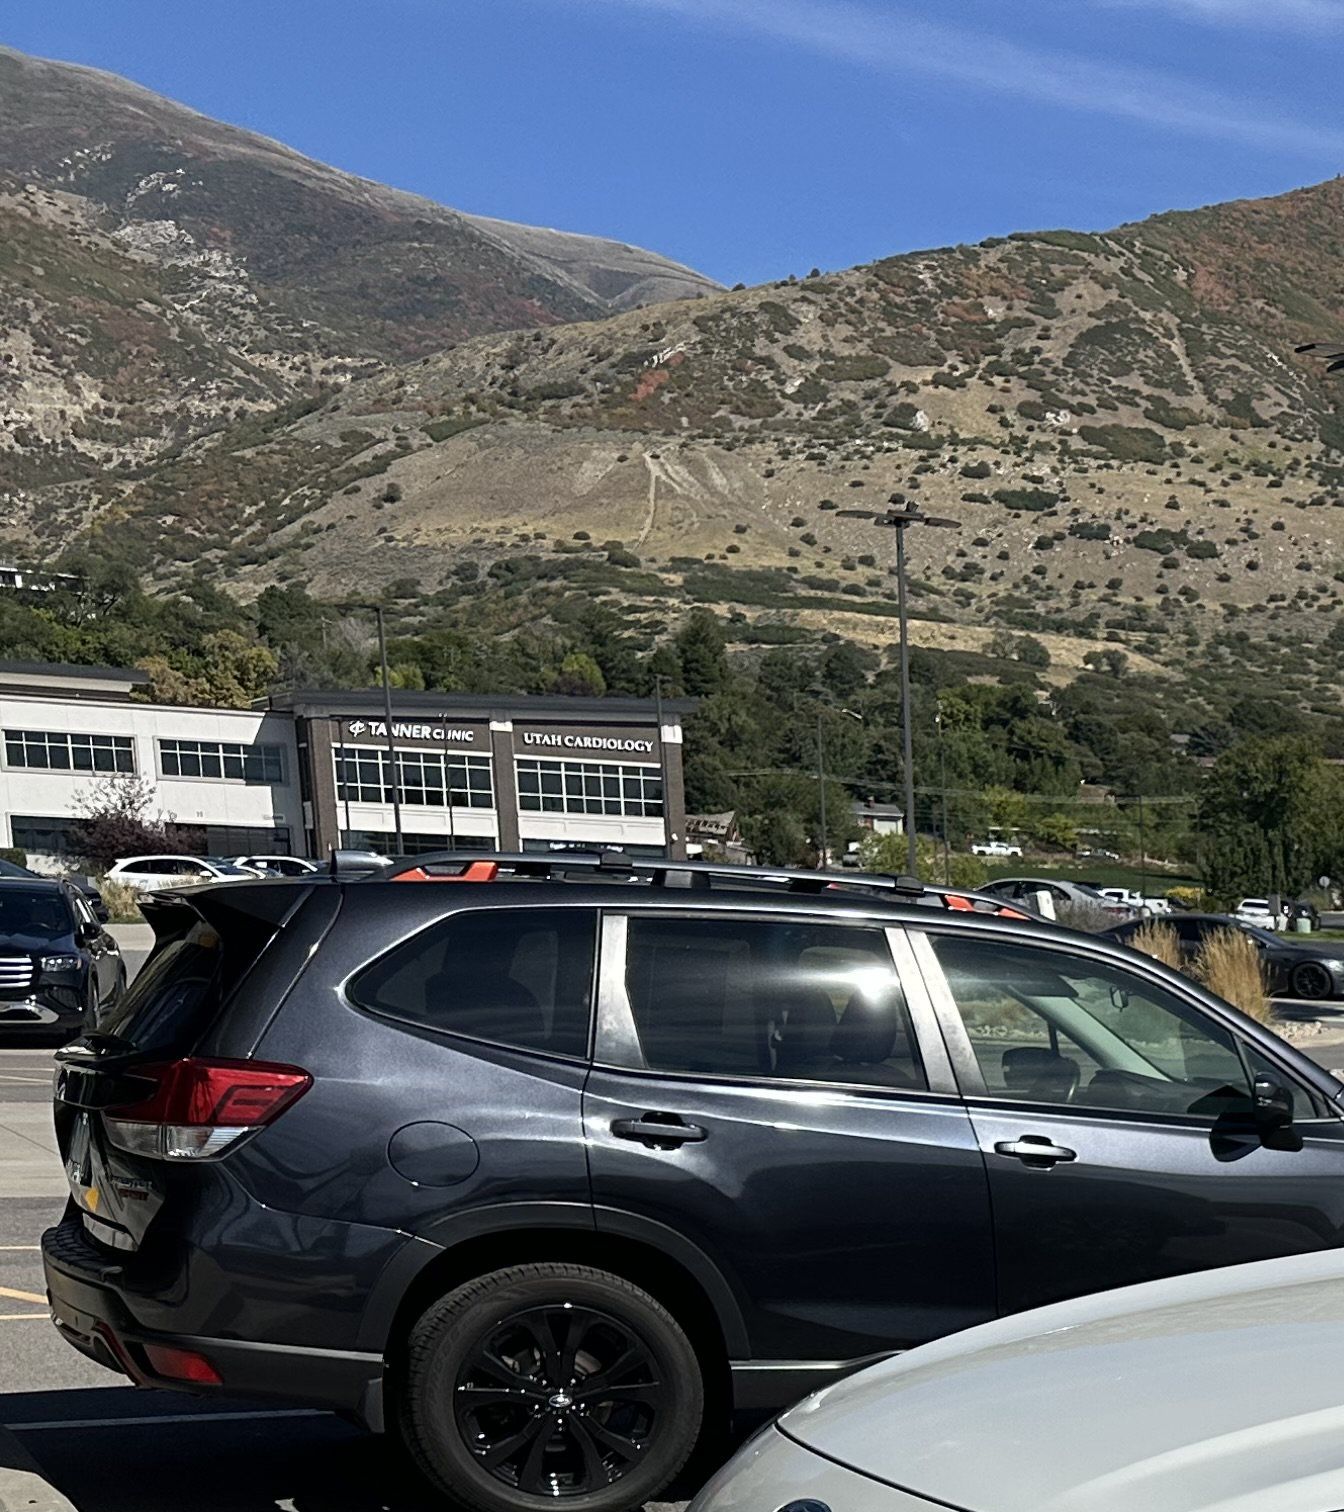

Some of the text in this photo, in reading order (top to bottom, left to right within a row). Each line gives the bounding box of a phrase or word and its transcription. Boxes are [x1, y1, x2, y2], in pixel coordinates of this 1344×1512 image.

[368, 722, 474, 741] TANNER CLINIC
[523, 732, 654, 752] UTAH CARDIOLOGY
